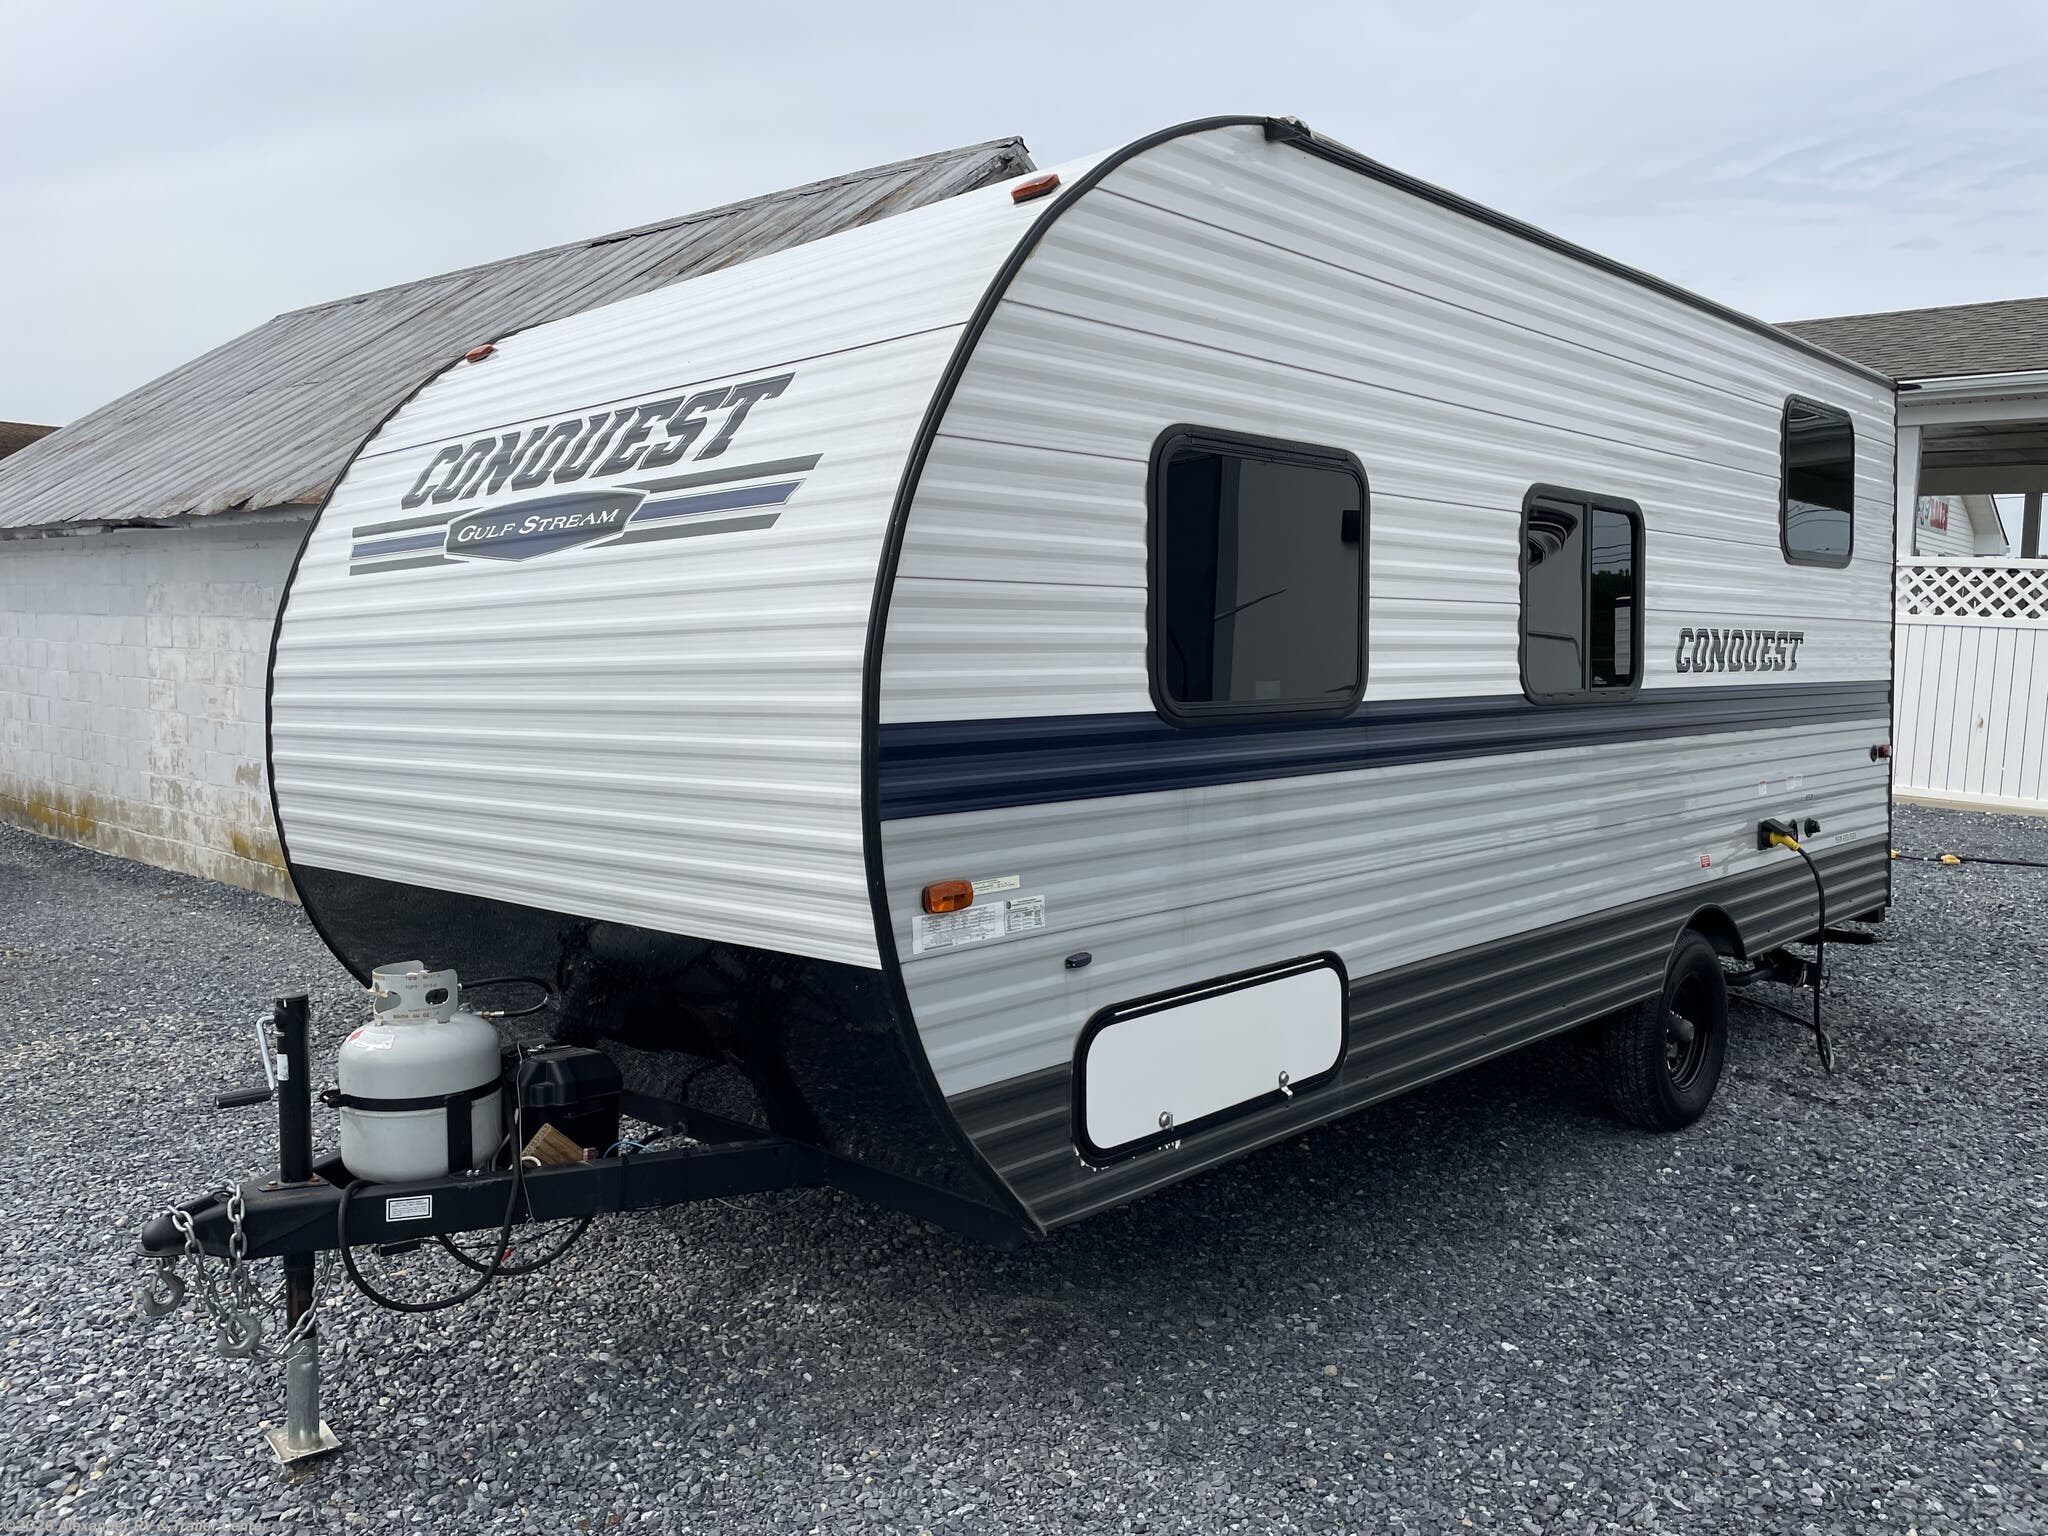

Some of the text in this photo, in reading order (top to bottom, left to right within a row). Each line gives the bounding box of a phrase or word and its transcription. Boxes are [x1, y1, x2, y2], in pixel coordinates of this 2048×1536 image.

[400, 372, 797, 510] CONQUEST
[457, 508, 620, 543] GULF STREAM
[1676, 627, 1804, 673] CONQUEST
